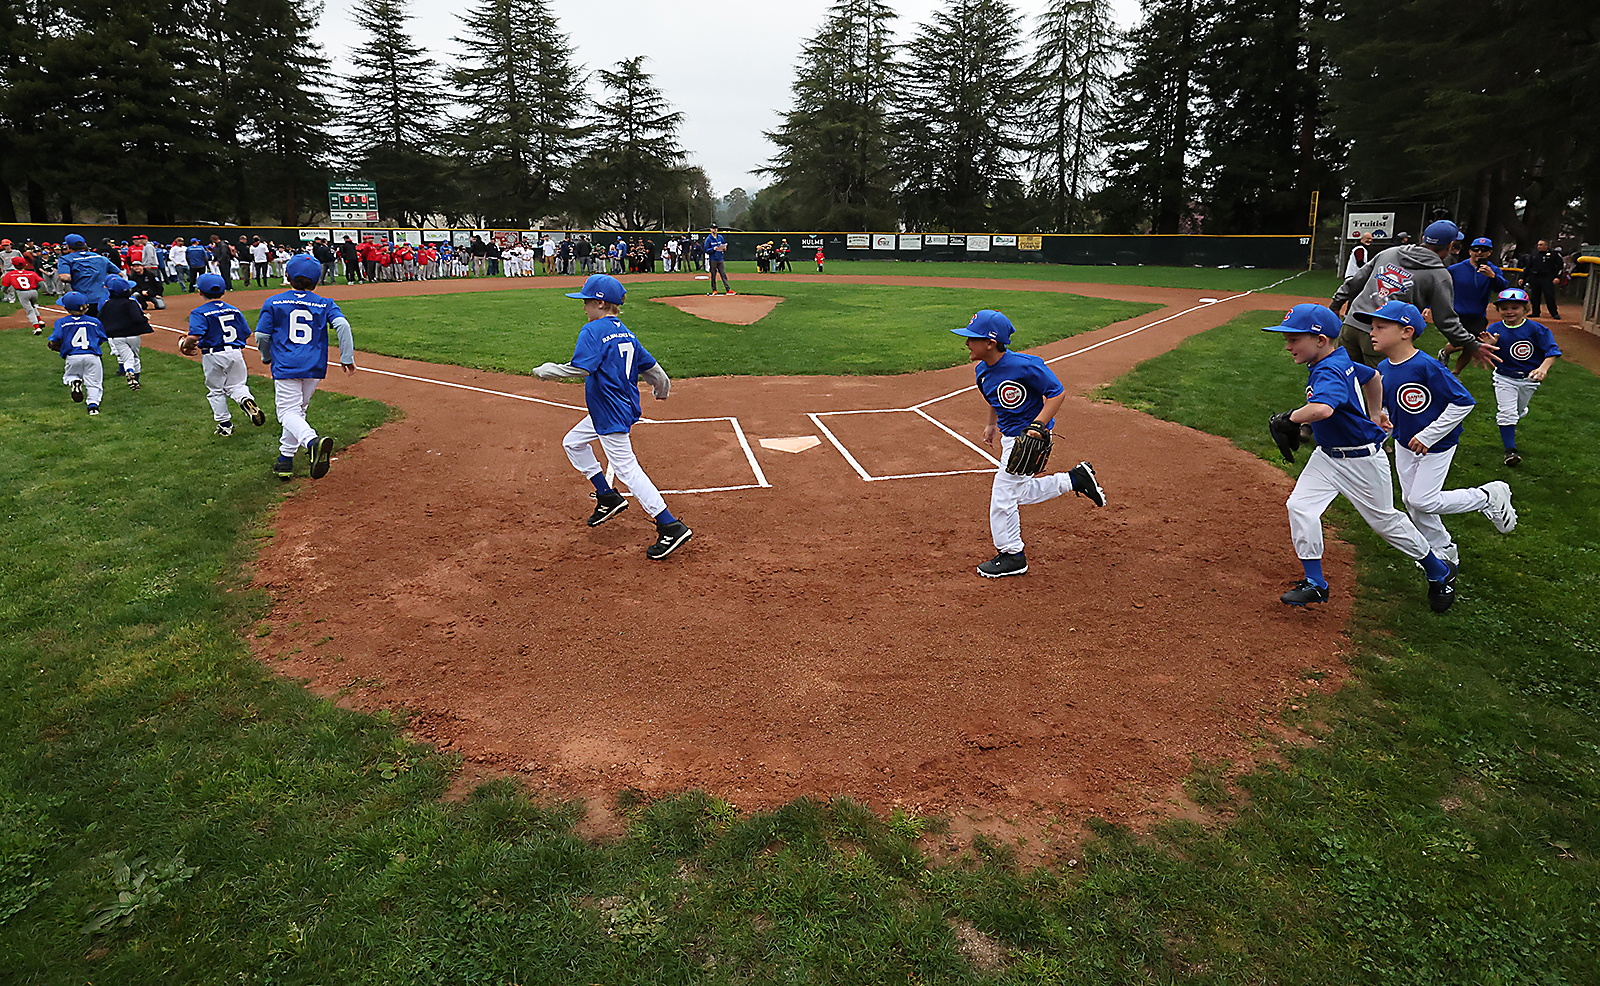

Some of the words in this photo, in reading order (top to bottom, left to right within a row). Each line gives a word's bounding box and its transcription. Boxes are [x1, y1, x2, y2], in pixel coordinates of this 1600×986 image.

[1353, 219, 1387, 228] Fruitist
[1299, 237, 1310, 245] 197
[16, 276, 31, 290] 8
[72, 326, 89, 349] 4
[218, 314, 238, 344] 5
[289, 309, 313, 345] 6
[617, 341, 635, 380] 7
